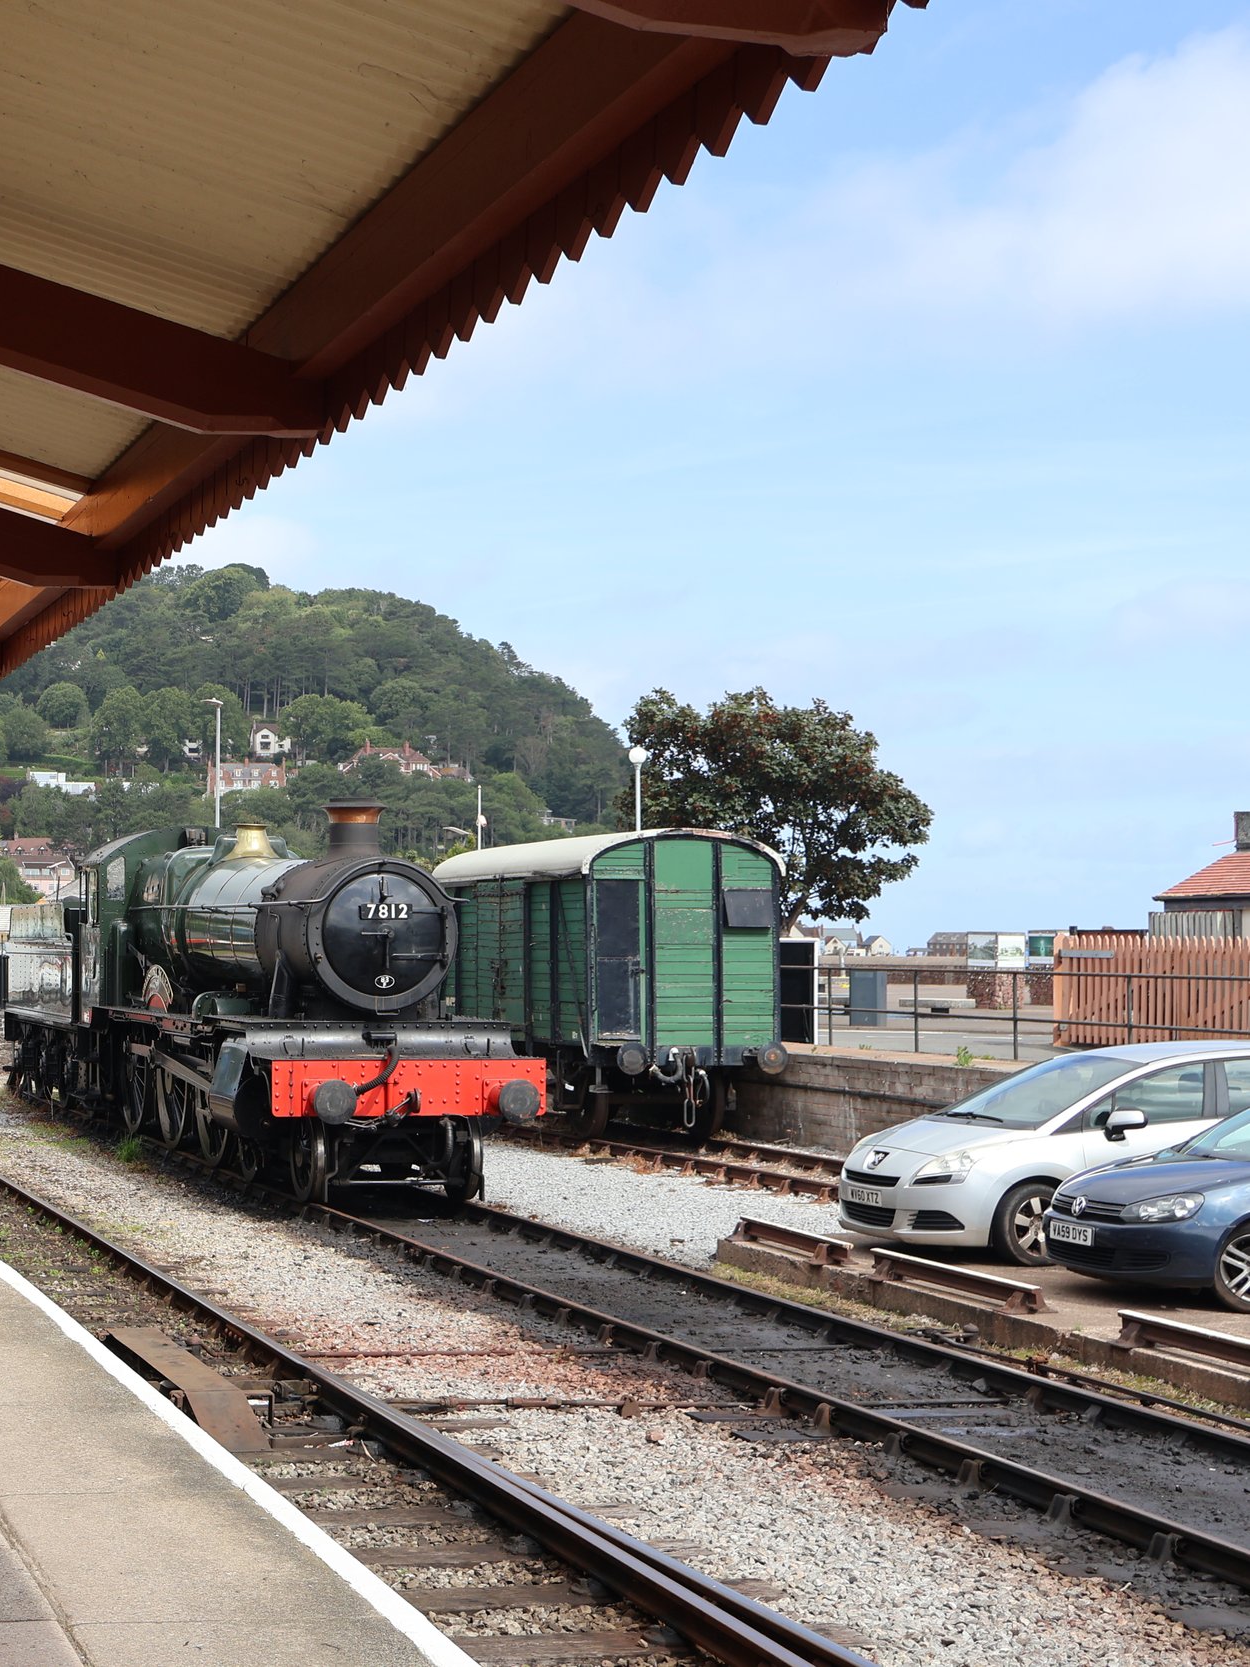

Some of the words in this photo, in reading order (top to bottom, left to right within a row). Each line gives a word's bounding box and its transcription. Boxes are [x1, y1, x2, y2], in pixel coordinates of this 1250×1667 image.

[366, 903, 408, 919] 7812
[865, 1191, 879, 1204] XTZ
[1052, 1223, 1071, 1239] VA59
[1071, 1226, 1088, 1242] DYS
